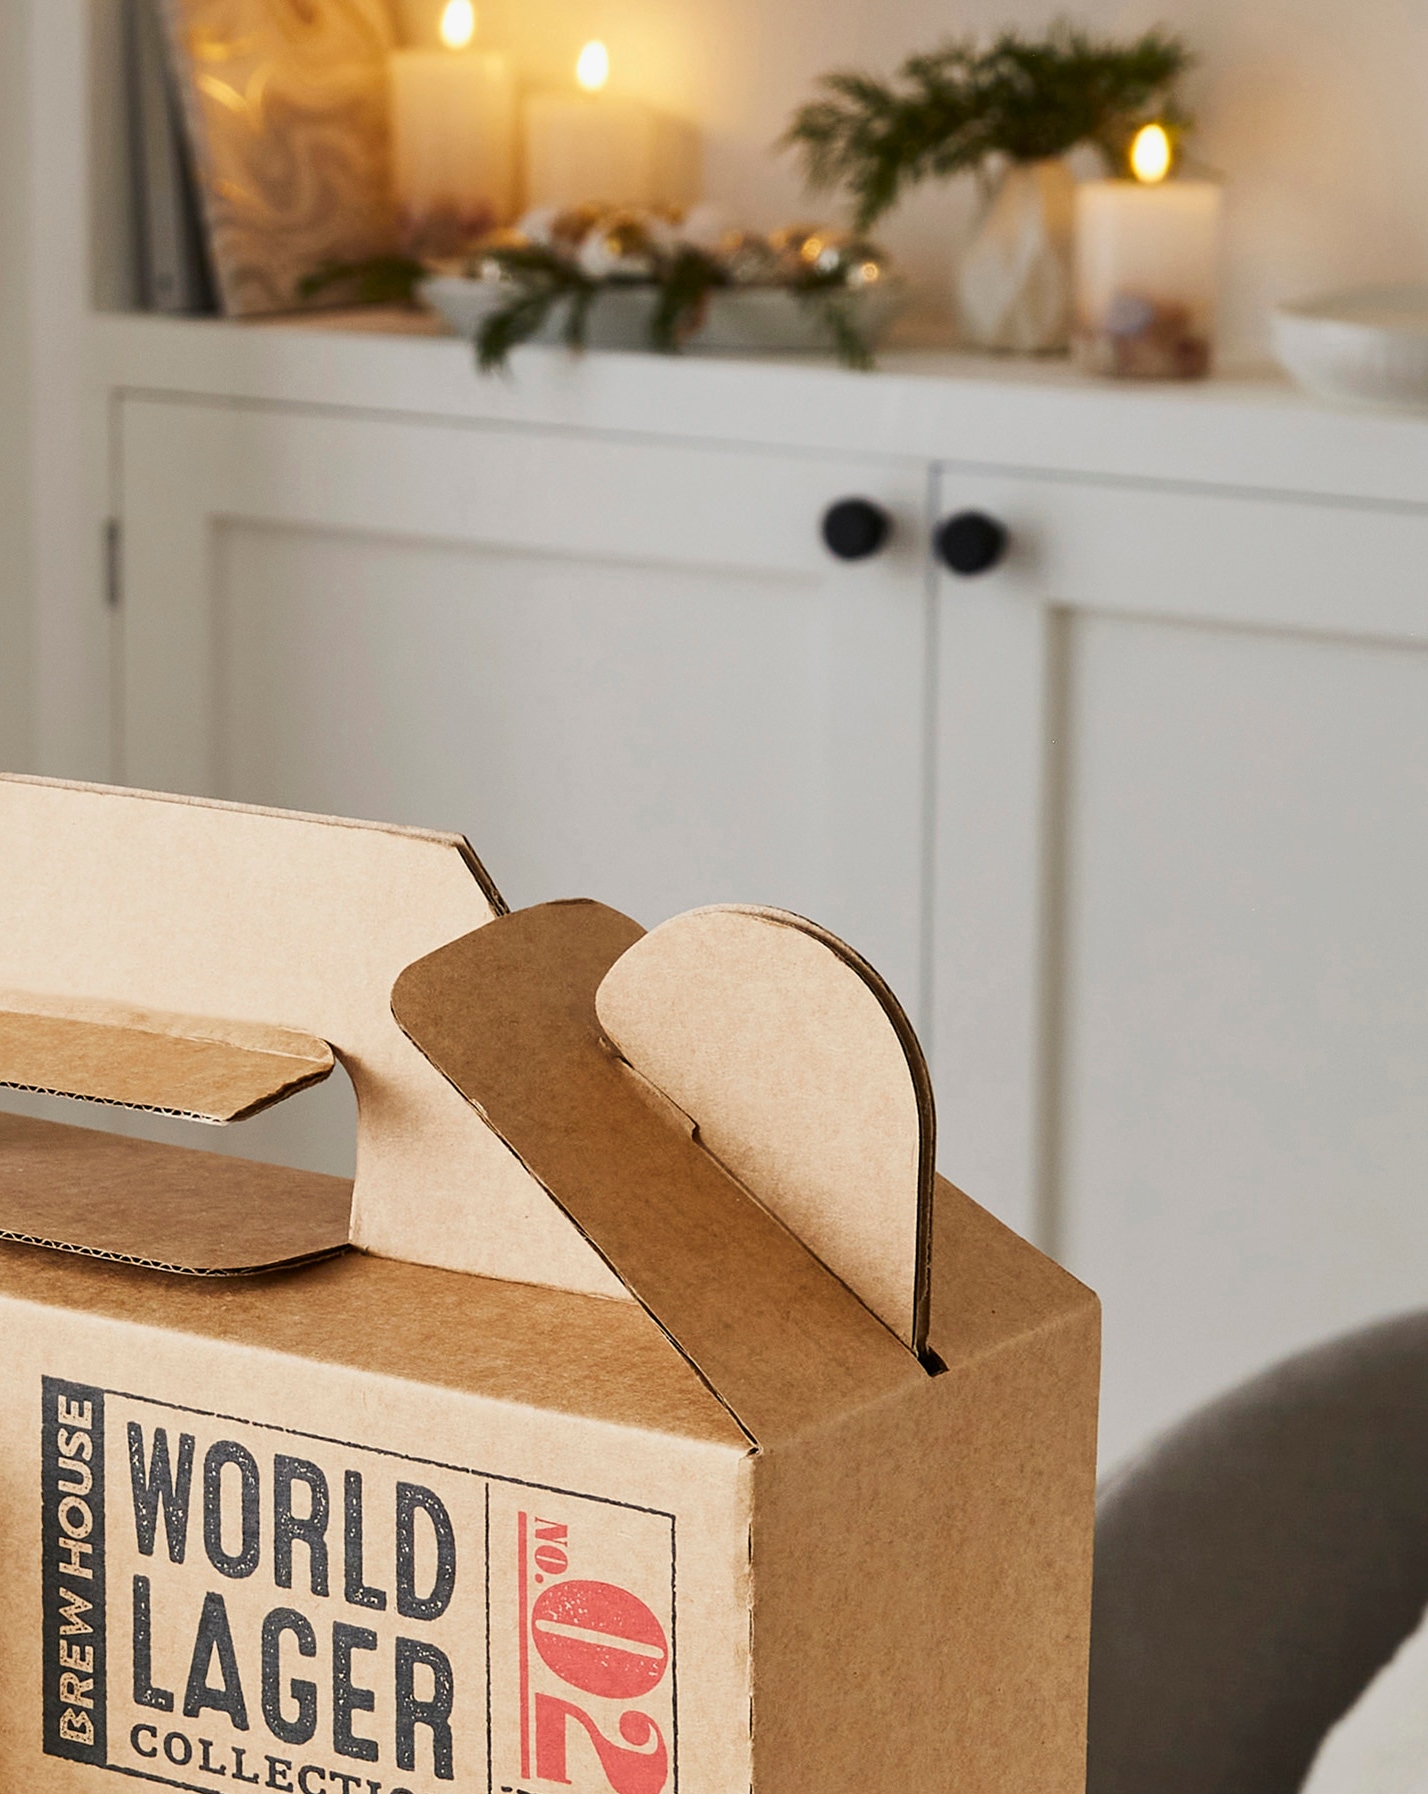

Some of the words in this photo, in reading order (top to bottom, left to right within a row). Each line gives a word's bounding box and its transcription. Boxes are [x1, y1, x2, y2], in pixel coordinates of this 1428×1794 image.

[57, 1394, 94, 1580] HOUSE
[126, 1421, 457, 1622] WORLD
[533, 1516, 569, 1584] NO.
[59, 1586, 94, 1746] BREW
[132, 1574, 455, 1782] LAGER
